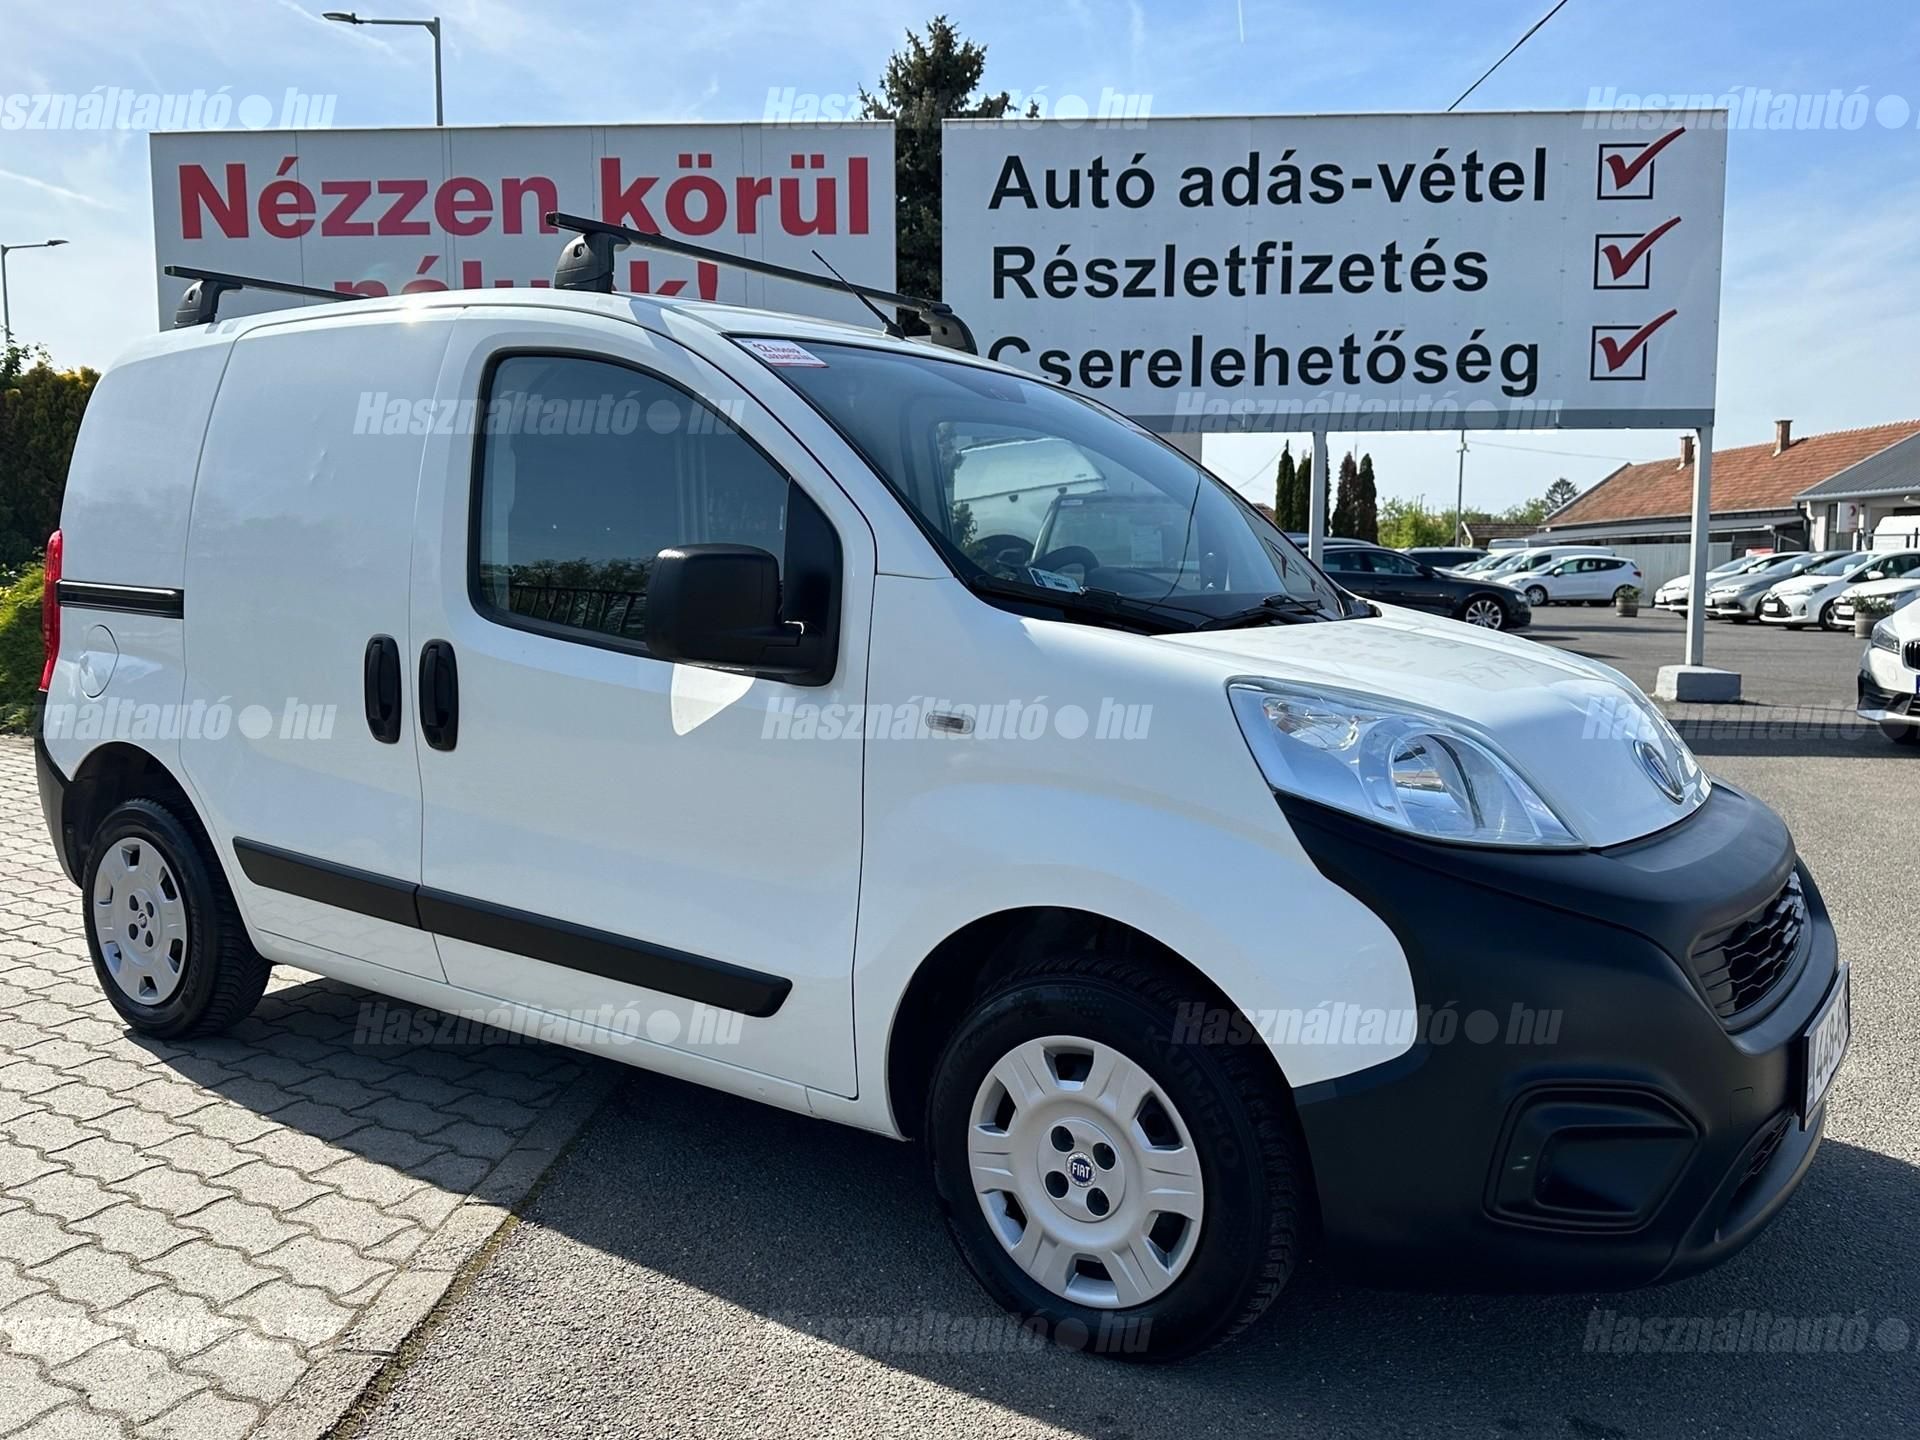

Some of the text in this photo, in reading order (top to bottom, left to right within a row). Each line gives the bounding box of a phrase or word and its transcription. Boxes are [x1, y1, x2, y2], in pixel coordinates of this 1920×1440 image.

[178, 153, 868, 240] Nézzen körül
[988, 147, 1547, 209] Autó adás-vétel
[992, 237, 1489, 299] Részletfizetés
[1072, 1162, 1091, 1179] FIAT
